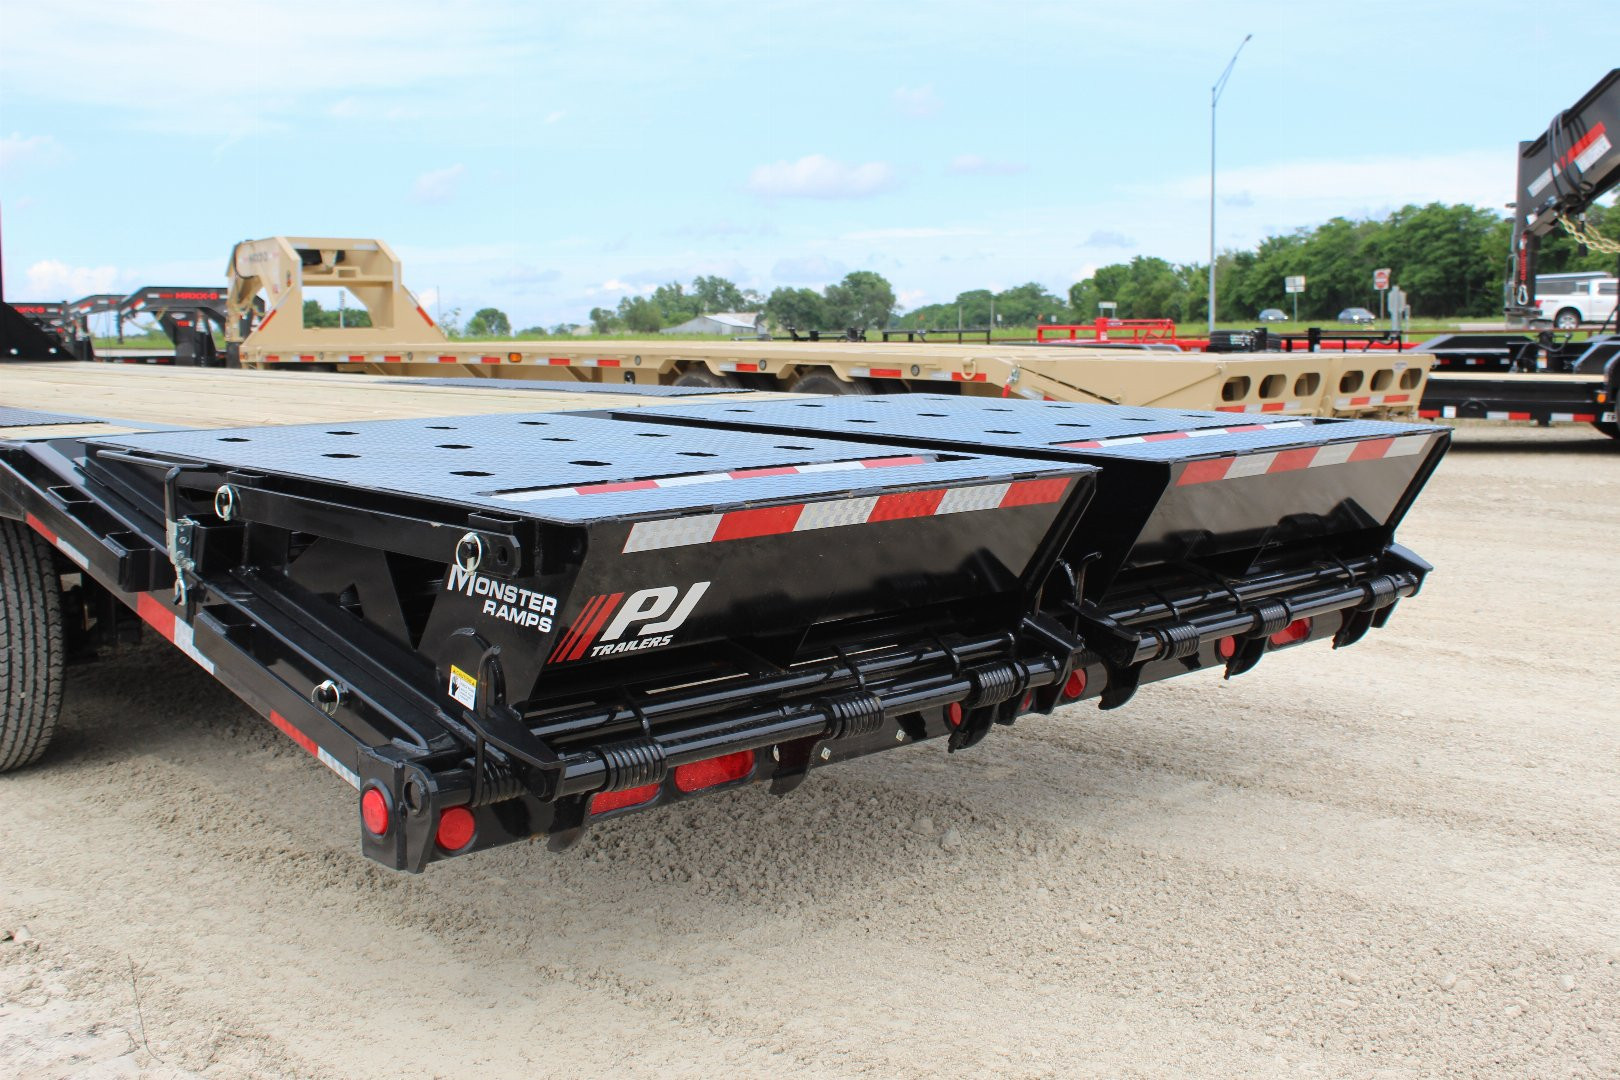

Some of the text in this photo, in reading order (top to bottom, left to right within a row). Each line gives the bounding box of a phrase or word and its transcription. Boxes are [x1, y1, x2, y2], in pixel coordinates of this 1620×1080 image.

[483, 599, 553, 633] RAMPS
[599, 581, 711, 642] PJ
[590, 634, 674, 658] TRAILERS
